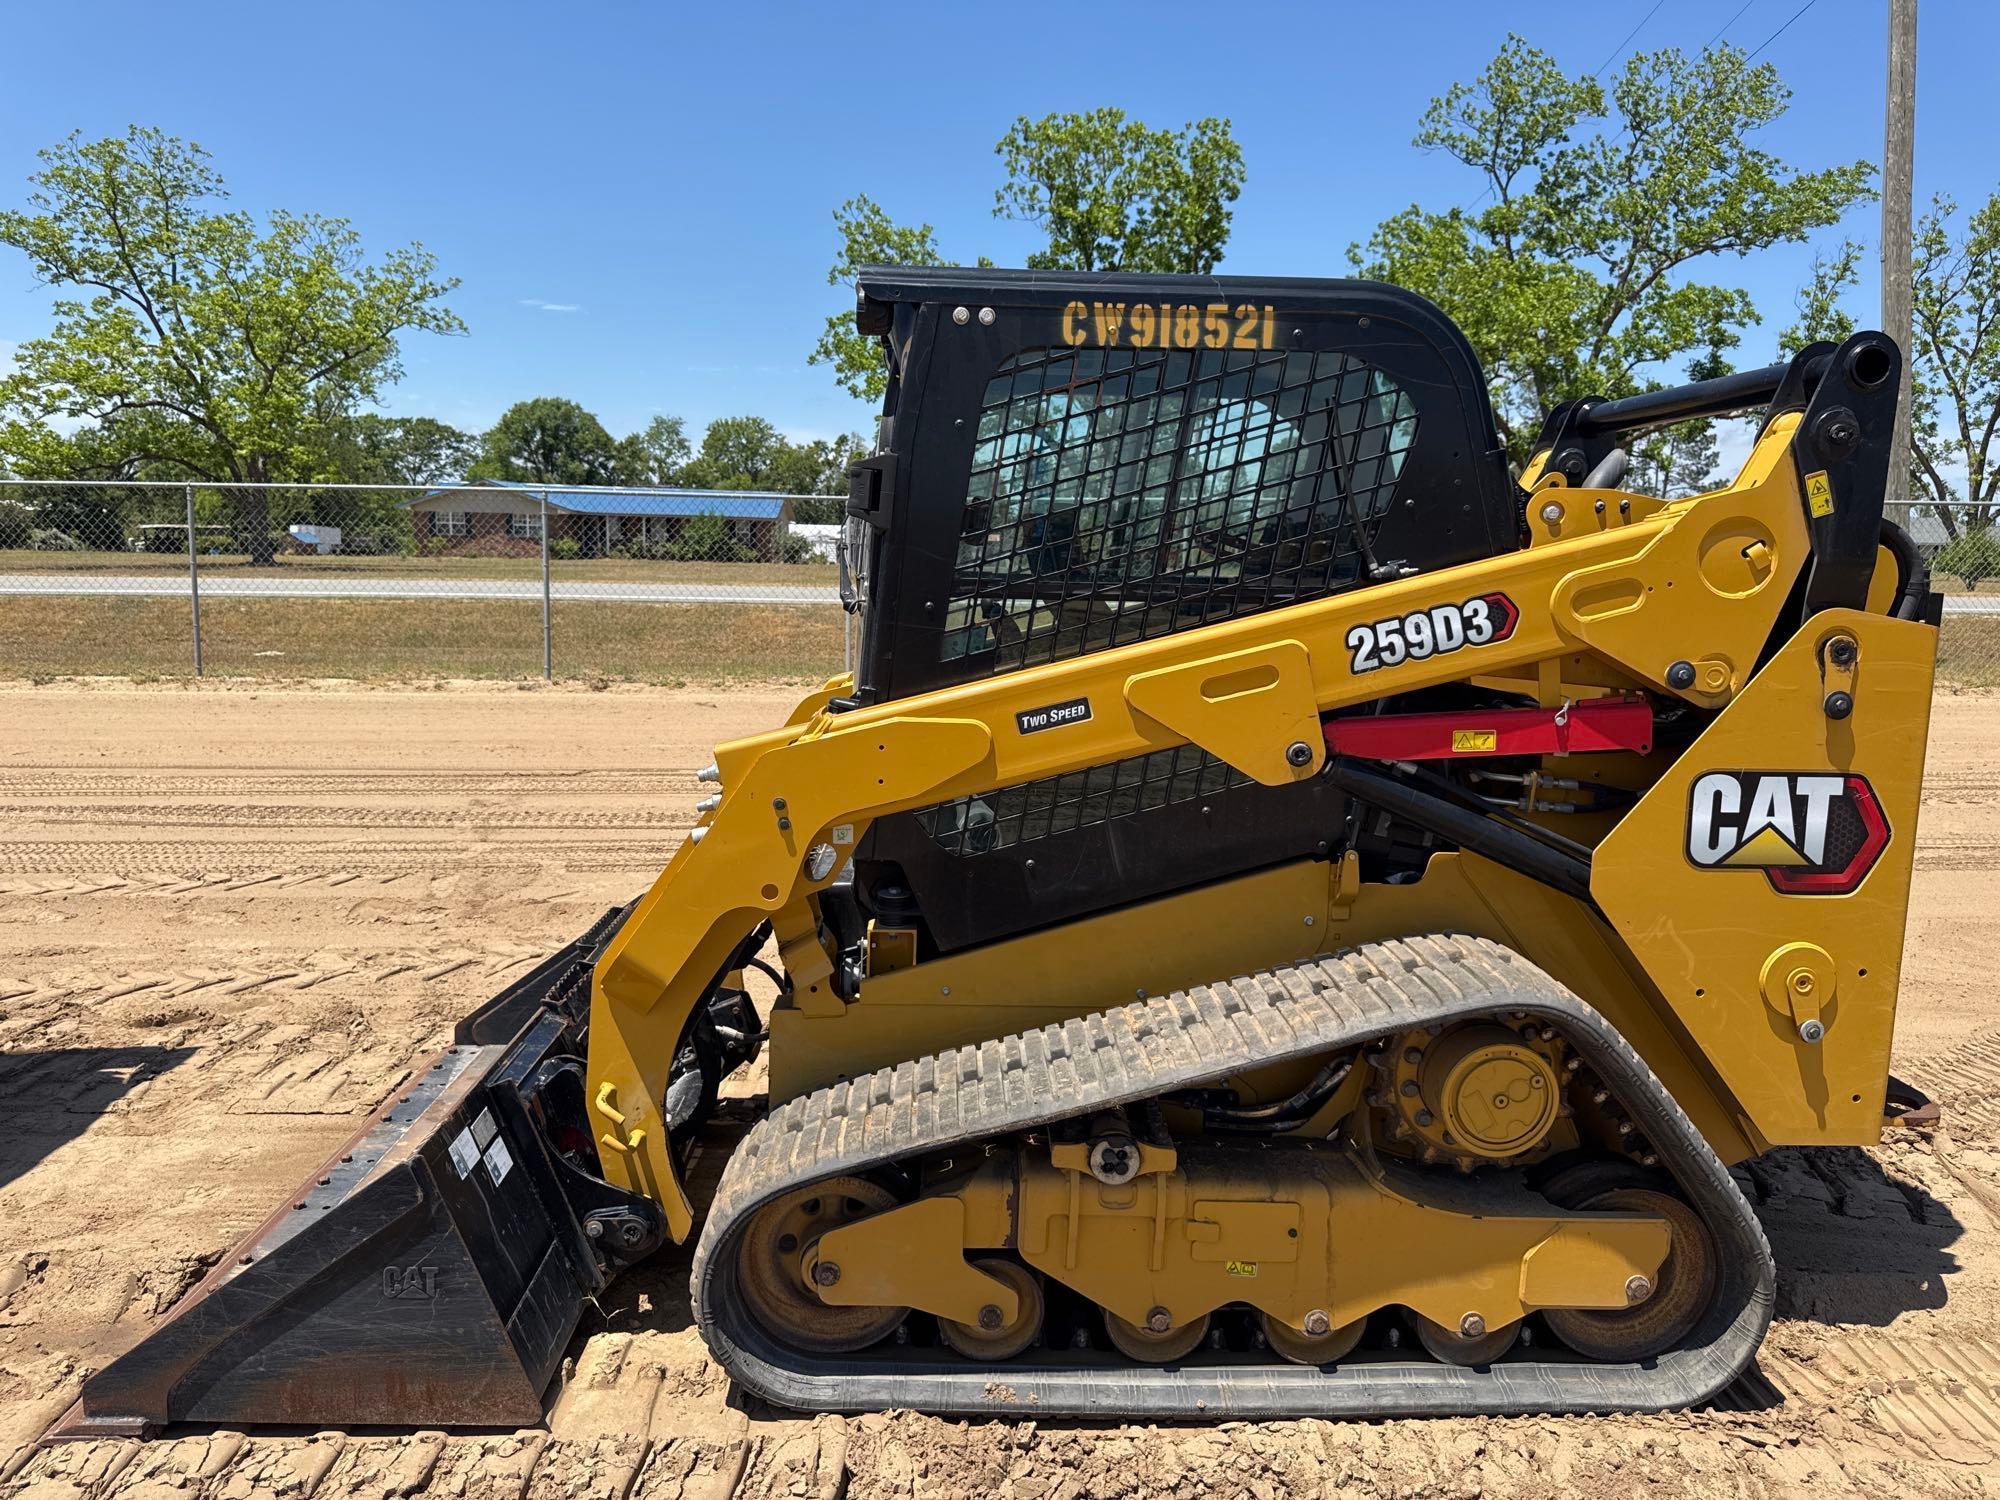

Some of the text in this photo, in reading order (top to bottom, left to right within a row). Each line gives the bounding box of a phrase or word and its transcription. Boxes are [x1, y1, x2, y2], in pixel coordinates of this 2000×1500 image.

[1062, 300, 1275, 350] CW918521
[1347, 599, 1493, 672] 259D3
[1689, 773, 1845, 866] CAT
[383, 1266, 439, 1298] CAT
